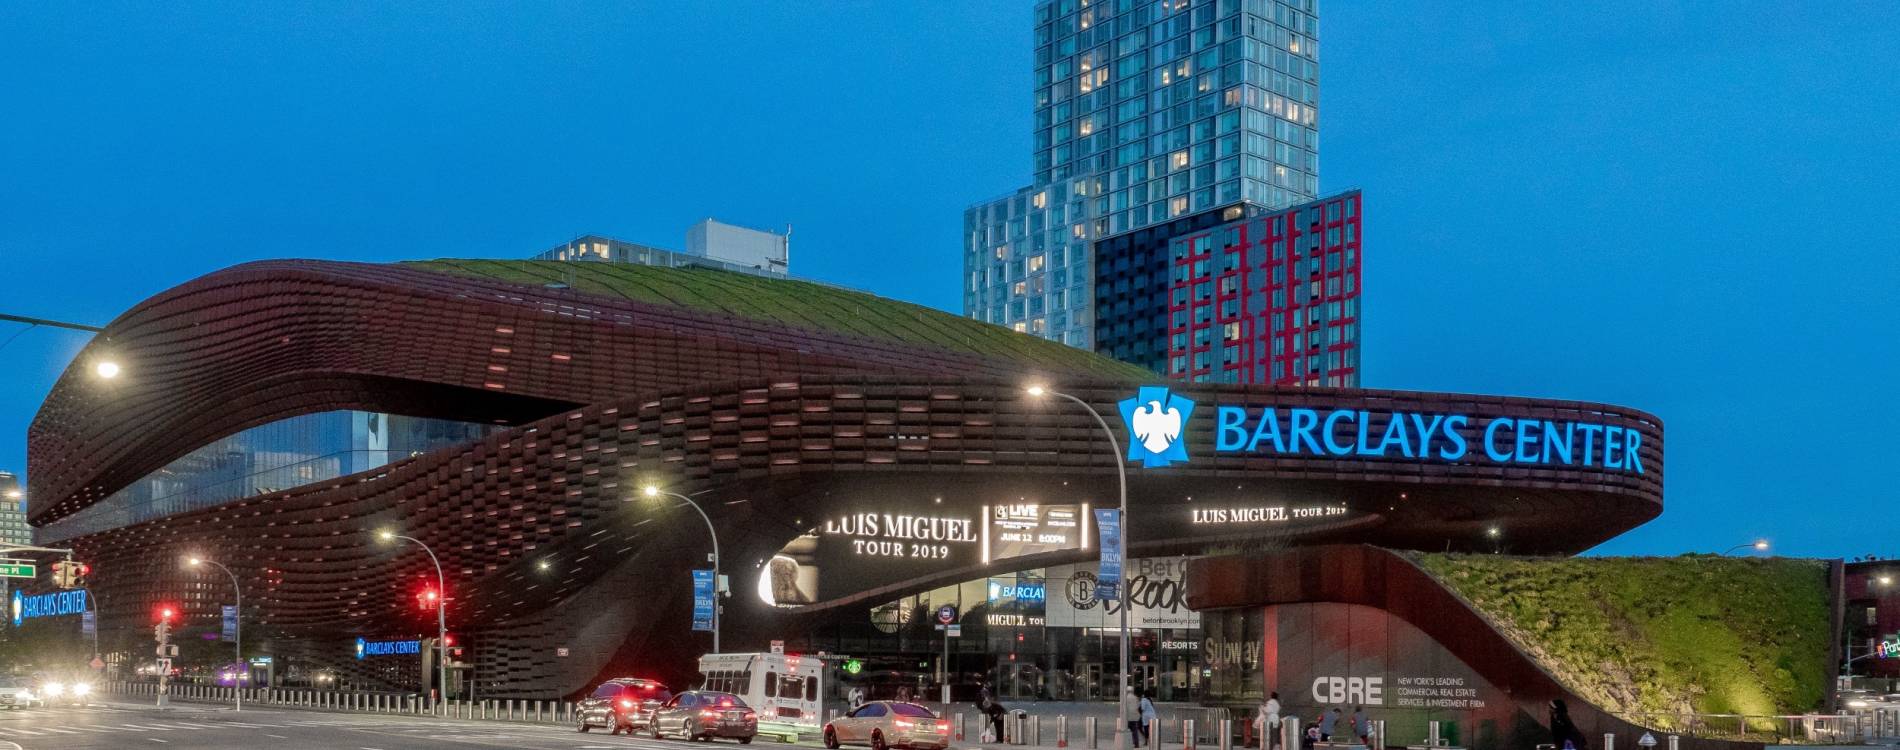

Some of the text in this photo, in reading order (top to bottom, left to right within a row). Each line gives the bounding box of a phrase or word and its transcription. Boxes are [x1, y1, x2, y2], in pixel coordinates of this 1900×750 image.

[1215, 405, 1645, 474] BARCLAYS CENTER
[1009, 504, 1038, 517] LIVE
[1193, 509, 1227, 523] LUIS
[1230, 507, 1288, 522] MIGUEL
[1293, 508, 1322, 518] TOUR
[825, 513, 977, 542] LUIS MIGUEL
[1001, 533, 1021, 542] JUNE
[1022, 534, 1032, 542] 12
[854, 540, 948, 558] TOUR 2019
[1140, 560, 1172, 576] Bet
[1079, 581, 1088, 601] B
[23, 590, 86, 617] BARCLAYS CENTER
[366, 640, 419, 654] BARCLAYS CENTER
[1162, 641, 1198, 649] RESORTS
[1205, 637, 1260, 669] Subway
[1398, 677, 1464, 686] NEW YORK'S LEADING
[1312, 676, 1383, 705] CBRE
[1398, 687, 1476, 697] COMMERCIAL REAL ESTATE
[1398, 698, 1485, 708] SERVICES & INVESTMENT FIRM
